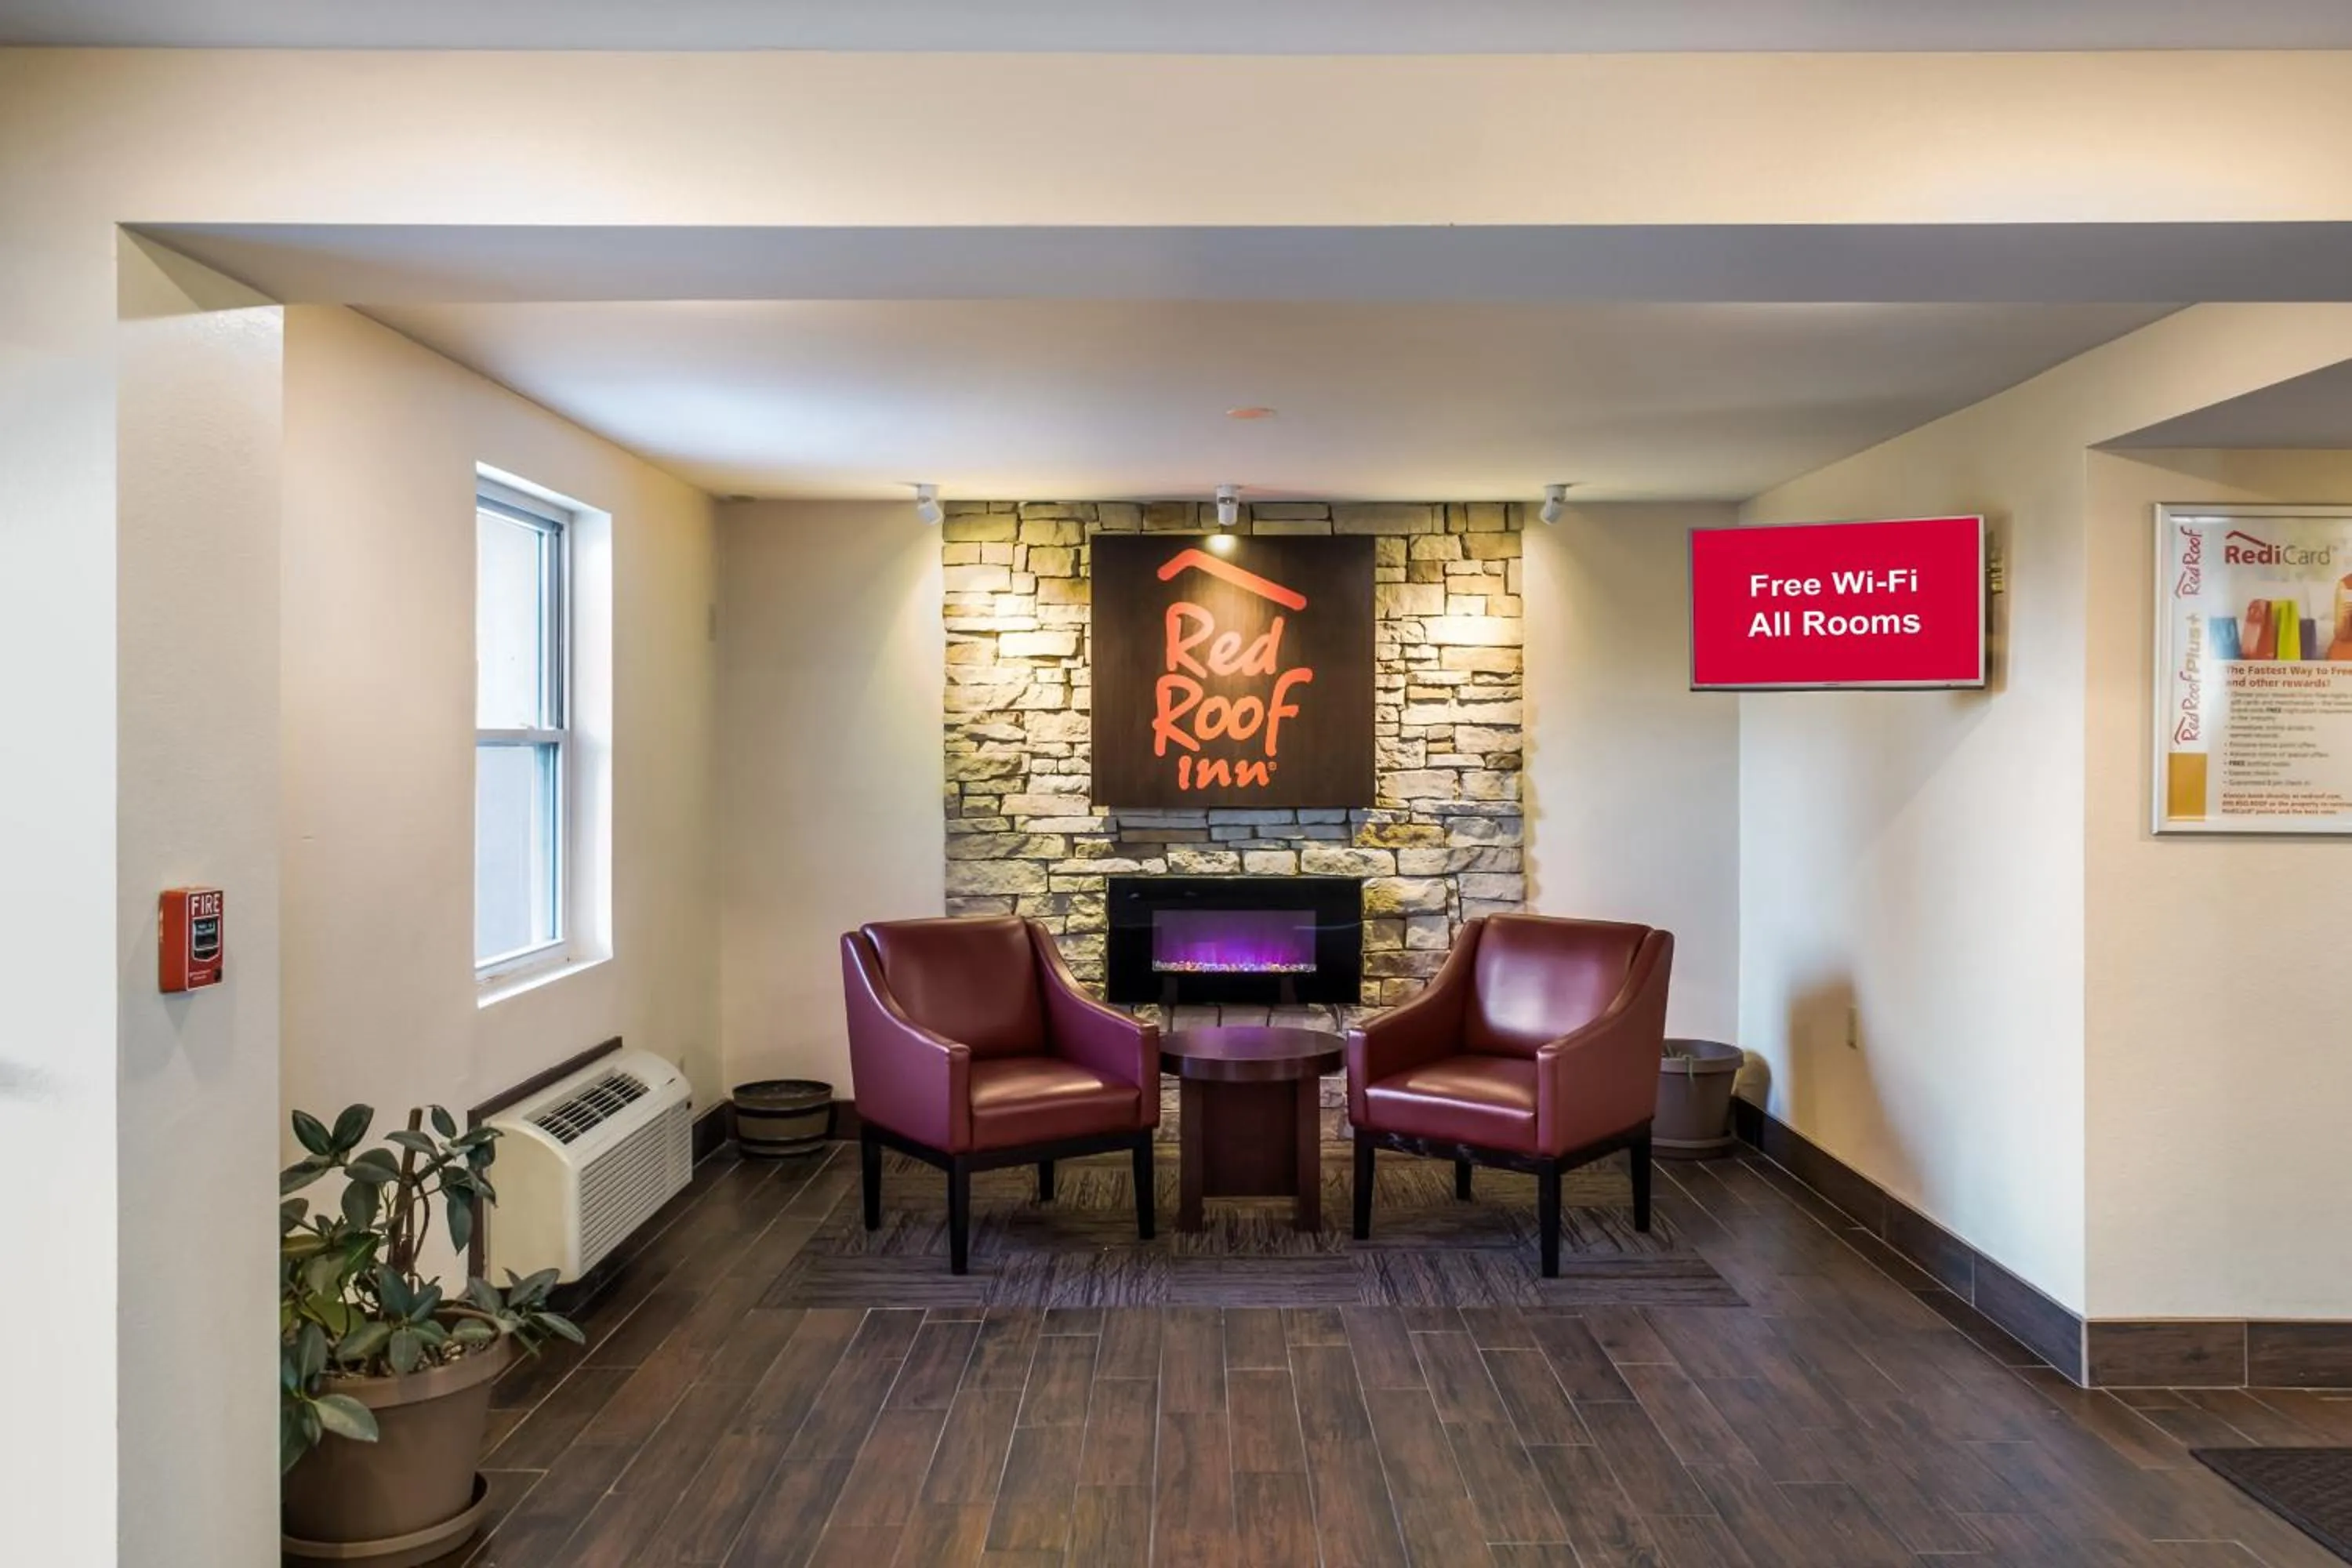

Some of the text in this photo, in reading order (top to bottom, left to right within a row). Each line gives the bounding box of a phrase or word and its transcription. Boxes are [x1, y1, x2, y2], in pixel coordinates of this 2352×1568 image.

[2224, 544, 2331, 565] RediCard
[1750, 568, 1919, 598] Free Wi-Fi
[1748, 609, 1922, 638] All Rooms
[1165, 601, 1285, 679] Red
[2226, 677, 2246, 688] and
[2249, 677, 2278, 688] other
[2248, 666, 2287, 675] Fastest
[2290, 666, 2313, 677] Way
[2317, 666, 2328, 675] to
[1152, 666, 1314, 757] Roof
[191, 893, 220, 916] FIRE
